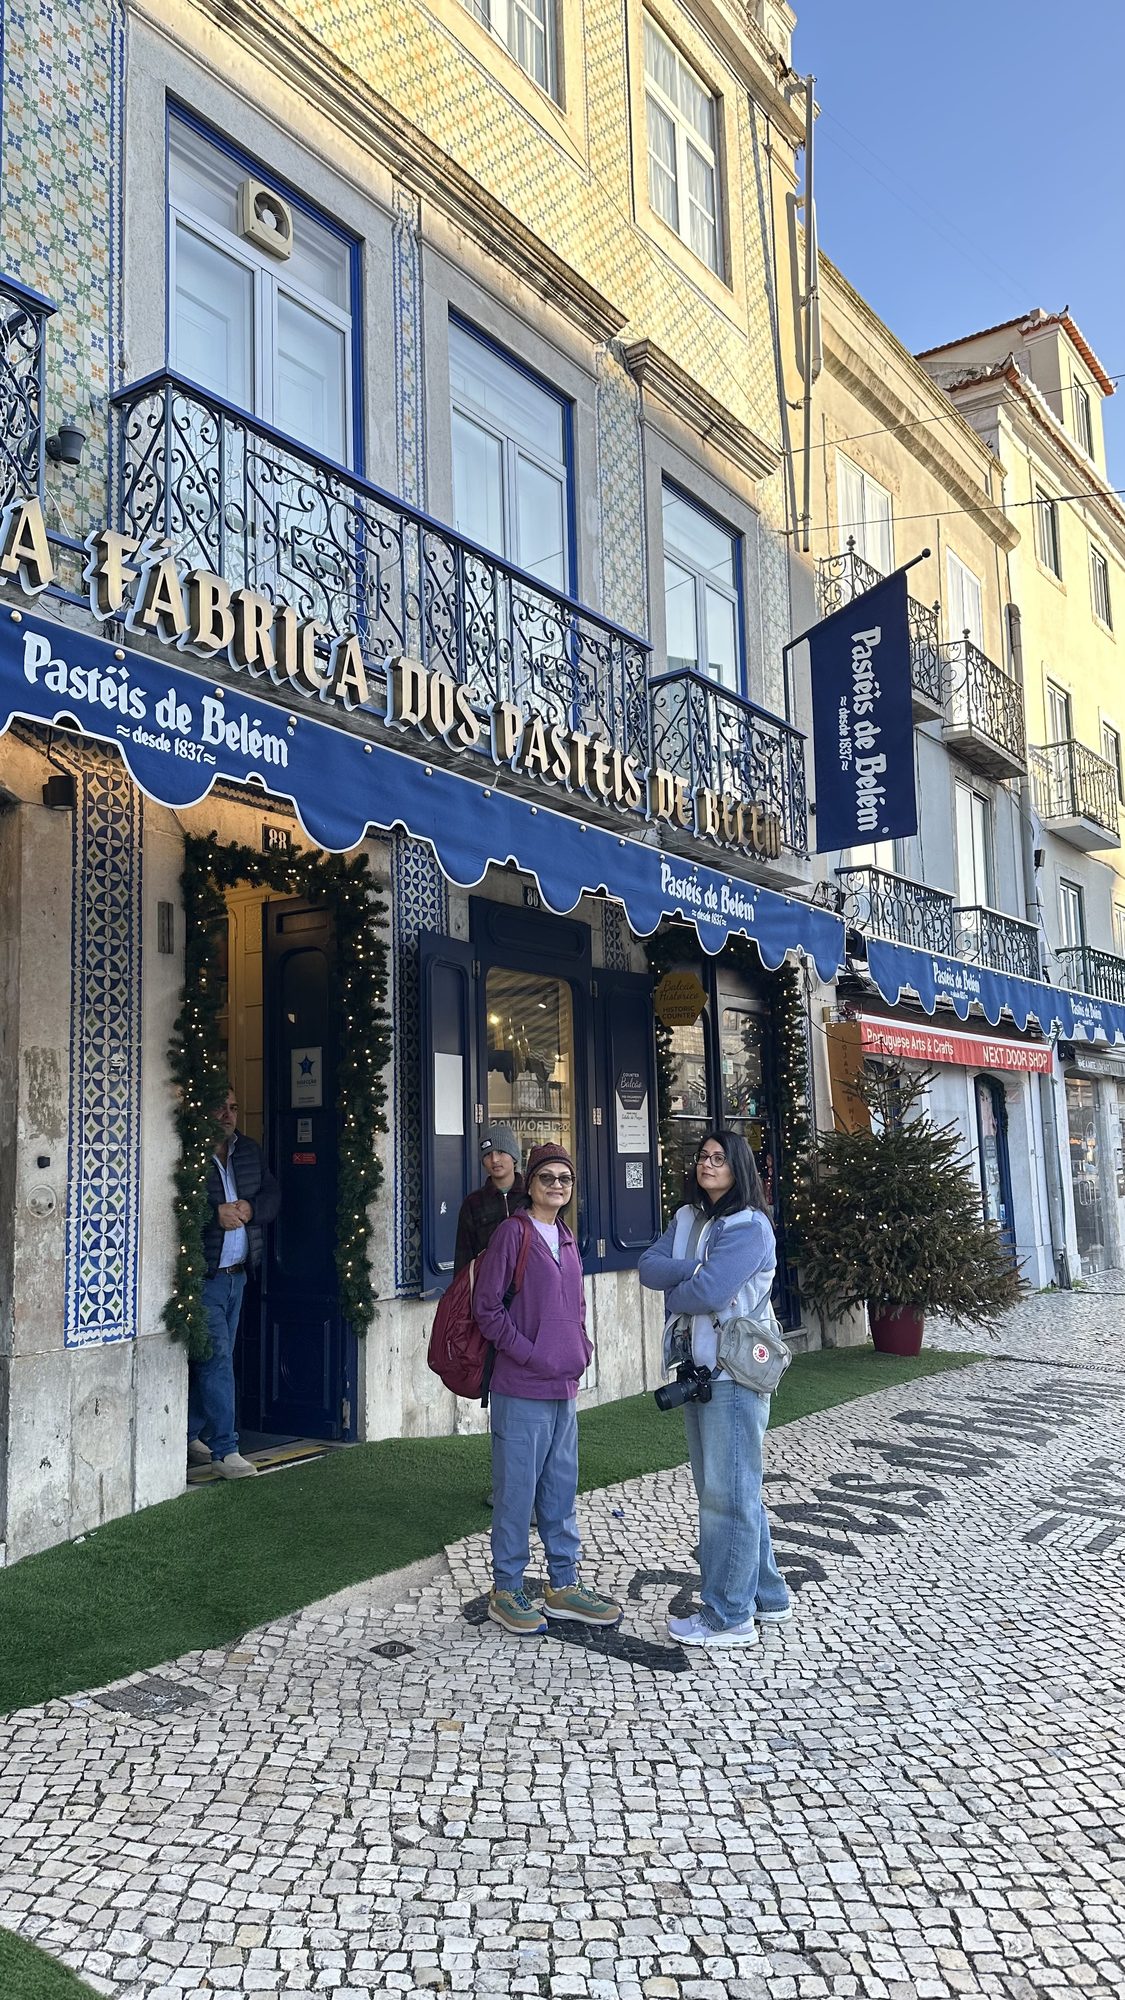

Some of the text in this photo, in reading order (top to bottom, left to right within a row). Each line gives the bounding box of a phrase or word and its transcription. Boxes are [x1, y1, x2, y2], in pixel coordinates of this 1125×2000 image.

[90, 528, 371, 706] FÁBRICA
[391, 656, 480, 750] DOS
[650, 767, 692, 829] DE
[22, 630, 289, 768] Pastéis de Belém
[132, 726, 205, 764] desde 1837
[838, 707, 852, 761] desde 1837
[851, 626, 887, 832] Pastéis de Belém
[269, 829, 287, 850] 88
[661, 862, 755, 922] Pastéis de Belém
[697, 909, 723, 926] desde 1837
[955, 970, 962, 989] de
[663, 1005, 695, 1013] HISTORIC
[866, 1028, 954, 1056] Portuguese Arts & Crafts
[982, 1046, 1048, 1068] NEXT DOOR SHOP
